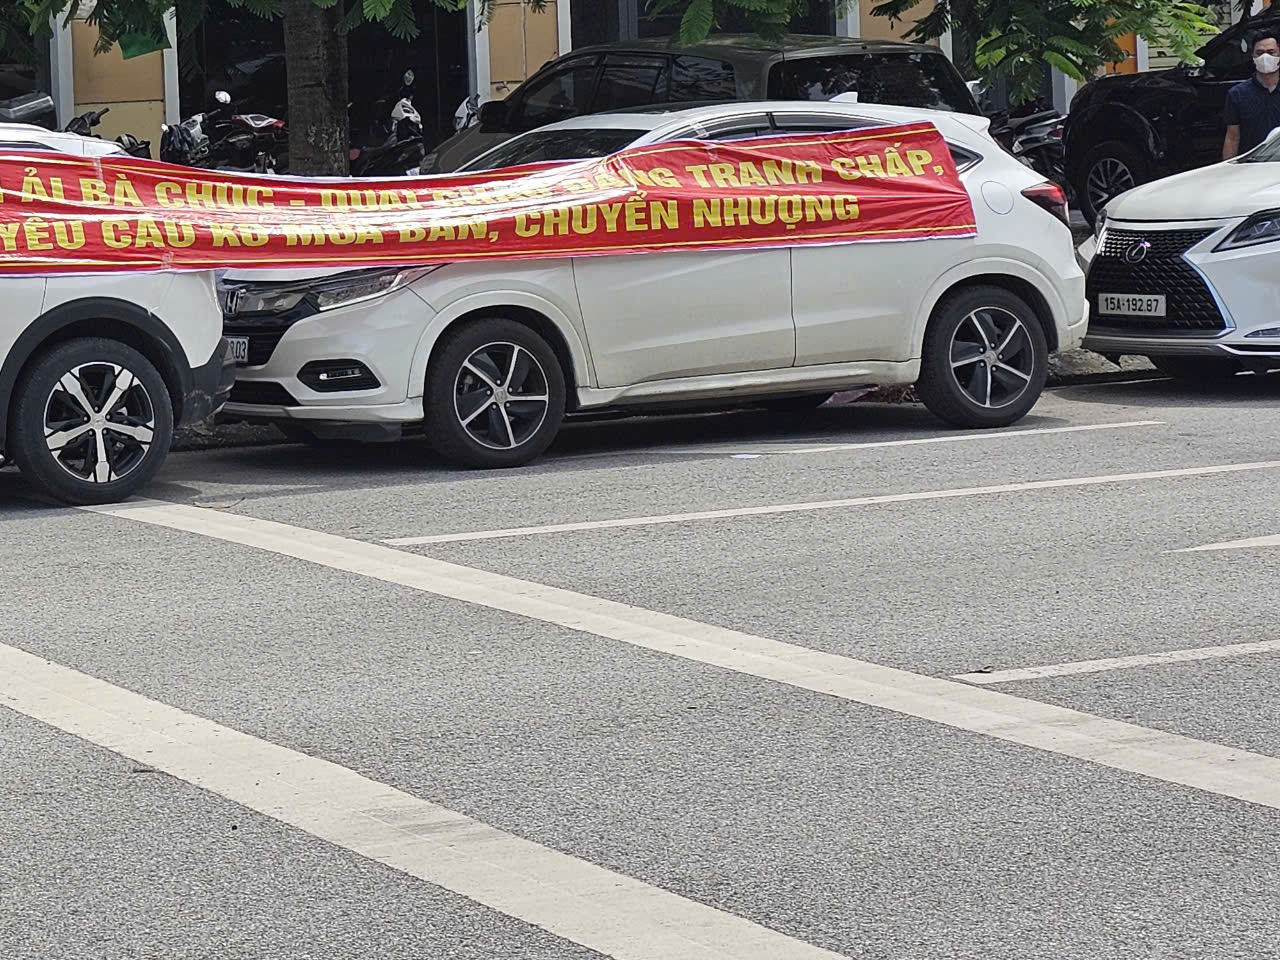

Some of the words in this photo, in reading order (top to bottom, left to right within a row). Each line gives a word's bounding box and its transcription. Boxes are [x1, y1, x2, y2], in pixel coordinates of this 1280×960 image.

[79, 173, 145, 208] BÀ
[685, 159, 823, 189] TRANH
[830, 142, 945, 181] CHẤP,
[514, 189, 680, 238] CHUYỂN
[692, 194, 860, 230] NHƯỢNG
